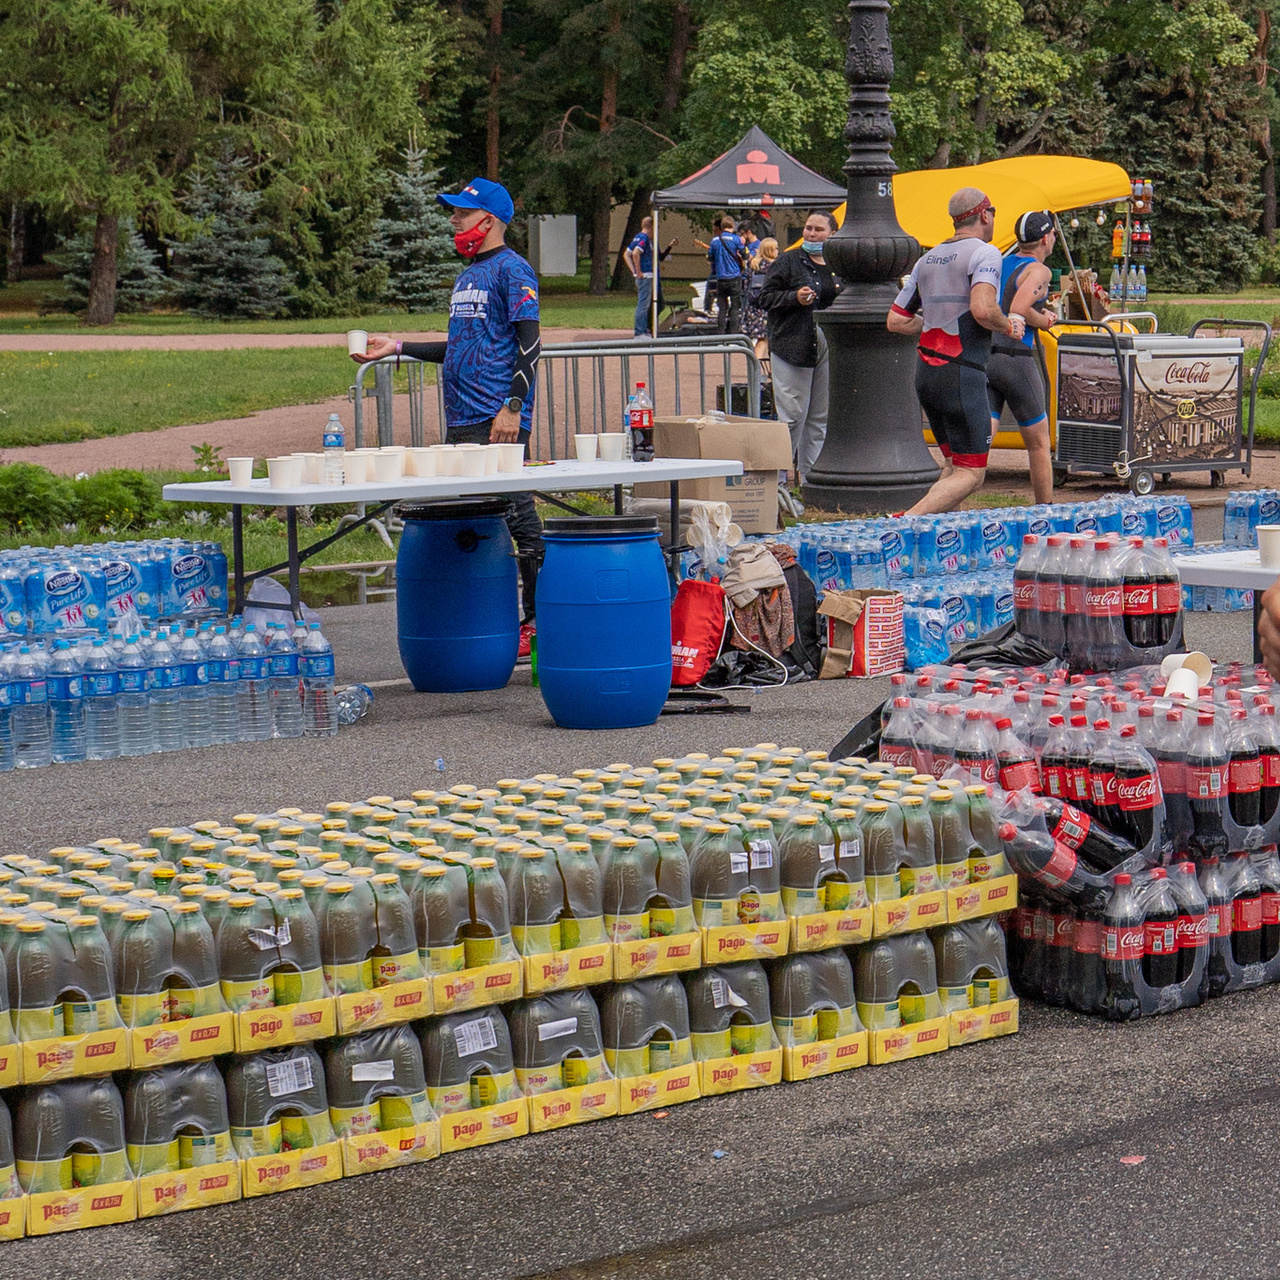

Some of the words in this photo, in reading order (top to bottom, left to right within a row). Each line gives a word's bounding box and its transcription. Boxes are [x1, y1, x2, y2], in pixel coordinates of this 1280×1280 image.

[1165, 361, 1212, 384] Coca-Cola
[51, 594, 70, 611] Pure
[67, 587, 87, 603] Life
[1117, 779, 1157, 799] Coca-Cola
